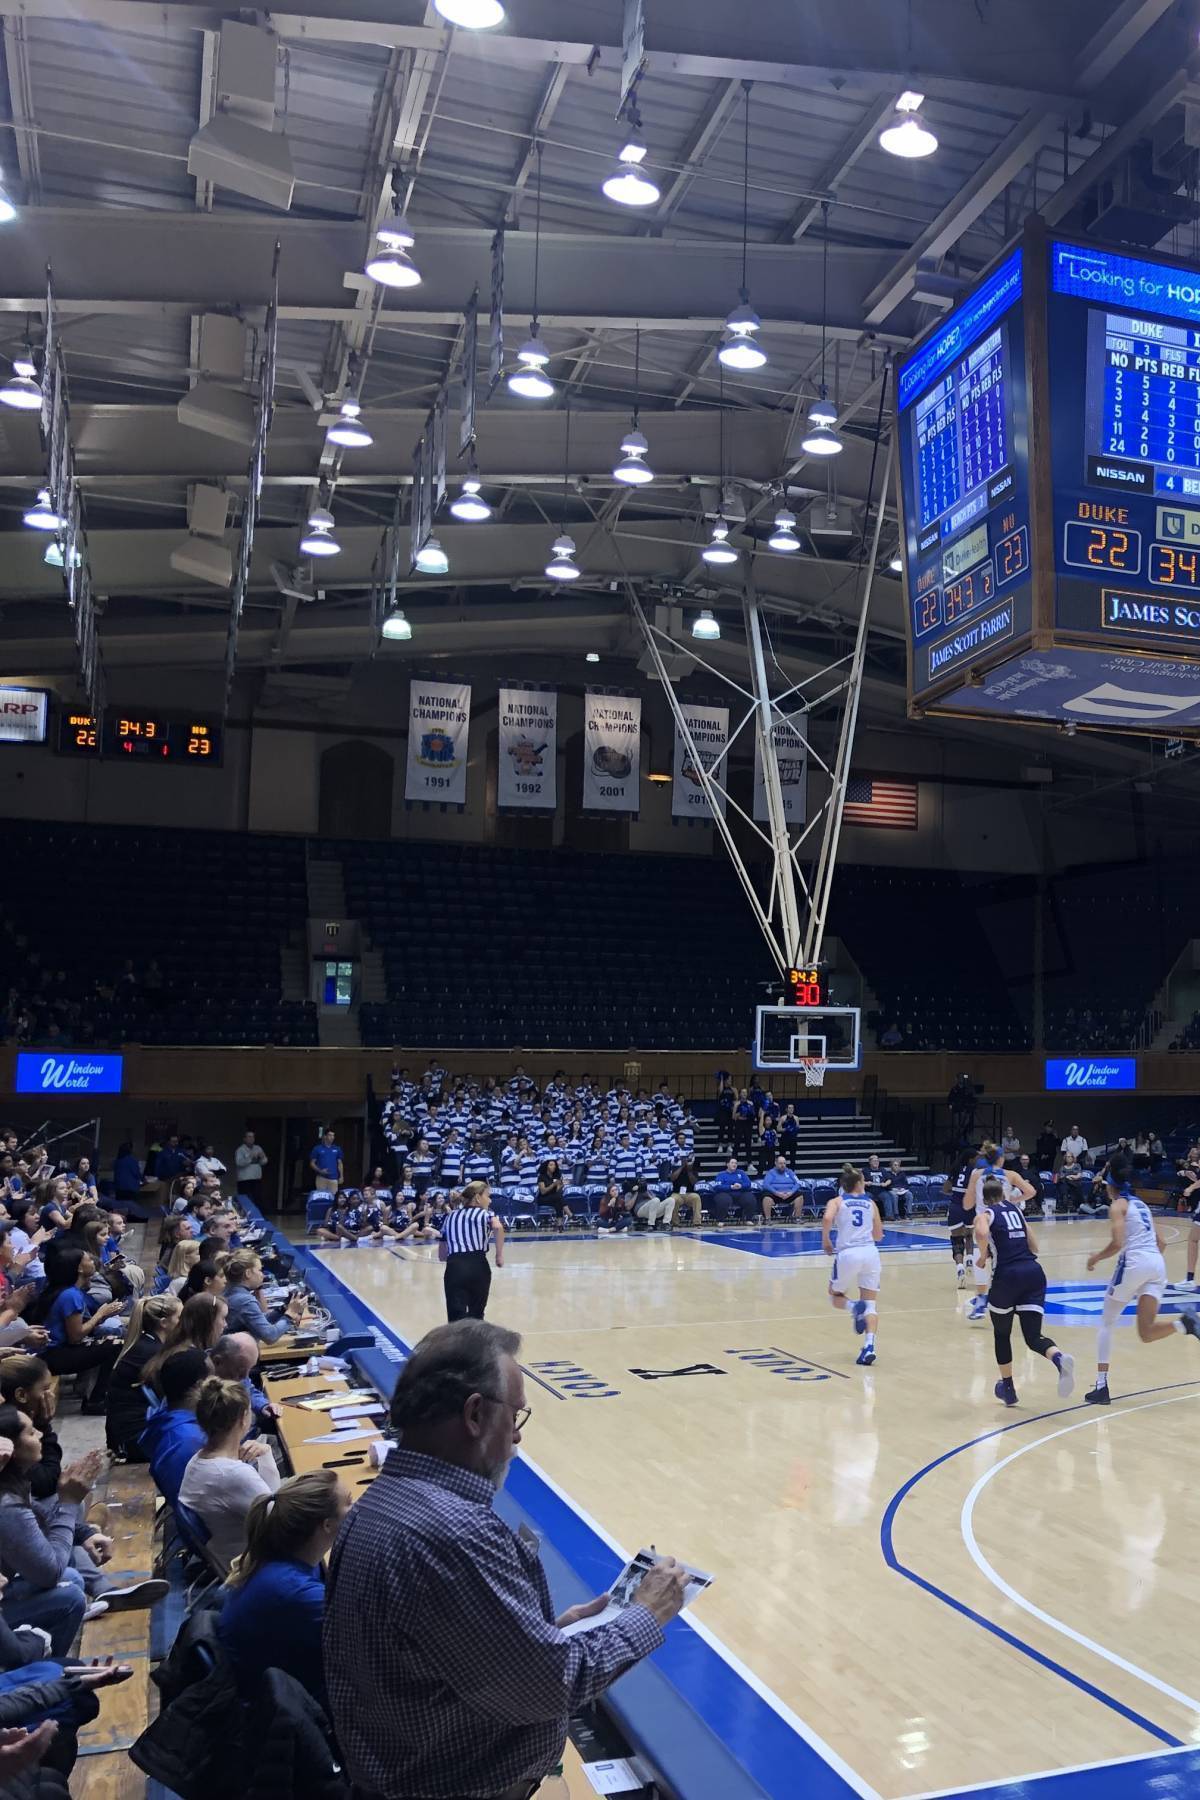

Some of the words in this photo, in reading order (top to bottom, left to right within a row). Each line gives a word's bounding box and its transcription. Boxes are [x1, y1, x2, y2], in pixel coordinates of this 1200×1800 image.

[1069, 262, 1136, 297] Looking
[1139, 276, 1161, 297] for
[1131, 320, 1164, 338] DUKE
[936, 326, 960, 360] HOPE?
[1144, 344, 1150, 356] 3
[1111, 352, 1128, 367] NO
[1135, 356, 1158, 374] PTS
[1162, 362, 1184, 379] REB
[1116, 371, 1123, 384] 2
[1143, 376, 1150, 389] 5
[1169, 381, 1176, 394] 2
[1197, 386, 1200, 399] 1
[1115, 387, 1123, 401] 3
[1142, 393, 1149, 406] 3
[1168, 398, 1176, 410] 4
[1196, 403, 1200, 416] 1
[1115, 405, 1122, 418] 5
[1142, 410, 1149, 423] 4
[1168, 415, 1176, 428] 3
[1112, 422, 1123, 435] 11
[1141, 427, 1148, 440] 2
[1167, 432, 1175, 445] 2
[1194, 436, 1200, 449] 0
[1110, 438, 1125, 452] 24
[1140, 444, 1148, 457] 0
[1167, 449, 1175, 462] 0
[1194, 453, 1200, 466] 1
[1096, 466, 1146, 484] NISSAN
[1166, 476, 1175, 490] 4
[1078, 502, 1129, 525] DUKE
[1004, 534, 1022, 575] 23
[1088, 529, 1128, 567] 22
[985, 576, 990, 594] 2
[948, 576, 974, 620] 34.3
[922, 592, 937, 628] 22
[1110, 598, 1170, 624] JAMES
[930, 646, 952, 673] JAMES
[954, 628, 980, 656] SCOTT
[980, 609, 1011, 641] FARRIN
[418, 696, 463, 709] NATIONAL
[508, 704, 549, 716] NATIONAL
[413, 708, 466, 723] CHAMPIONS
[502, 716, 554, 729] CHAMPIONS
[593, 708, 634, 721] NATIONAL
[119, 720, 156, 738] 34.3
[192, 726, 207, 735] NU
[588, 720, 638, 734] CHAMPIONS
[188, 738, 210, 754] 23
[424, 777, 450, 788] 1991
[516, 783, 542, 793] 1992
[600, 786, 625, 796] 2001
[796, 984, 820, 1006] 30
[41, 1058, 104, 1088] Window
[1065, 1062, 1120, 1086] Window
[956, 1174, 965, 1187] 2
[852, 1210, 863, 1226] 3
[1000, 1211, 1023, 1230] 10
